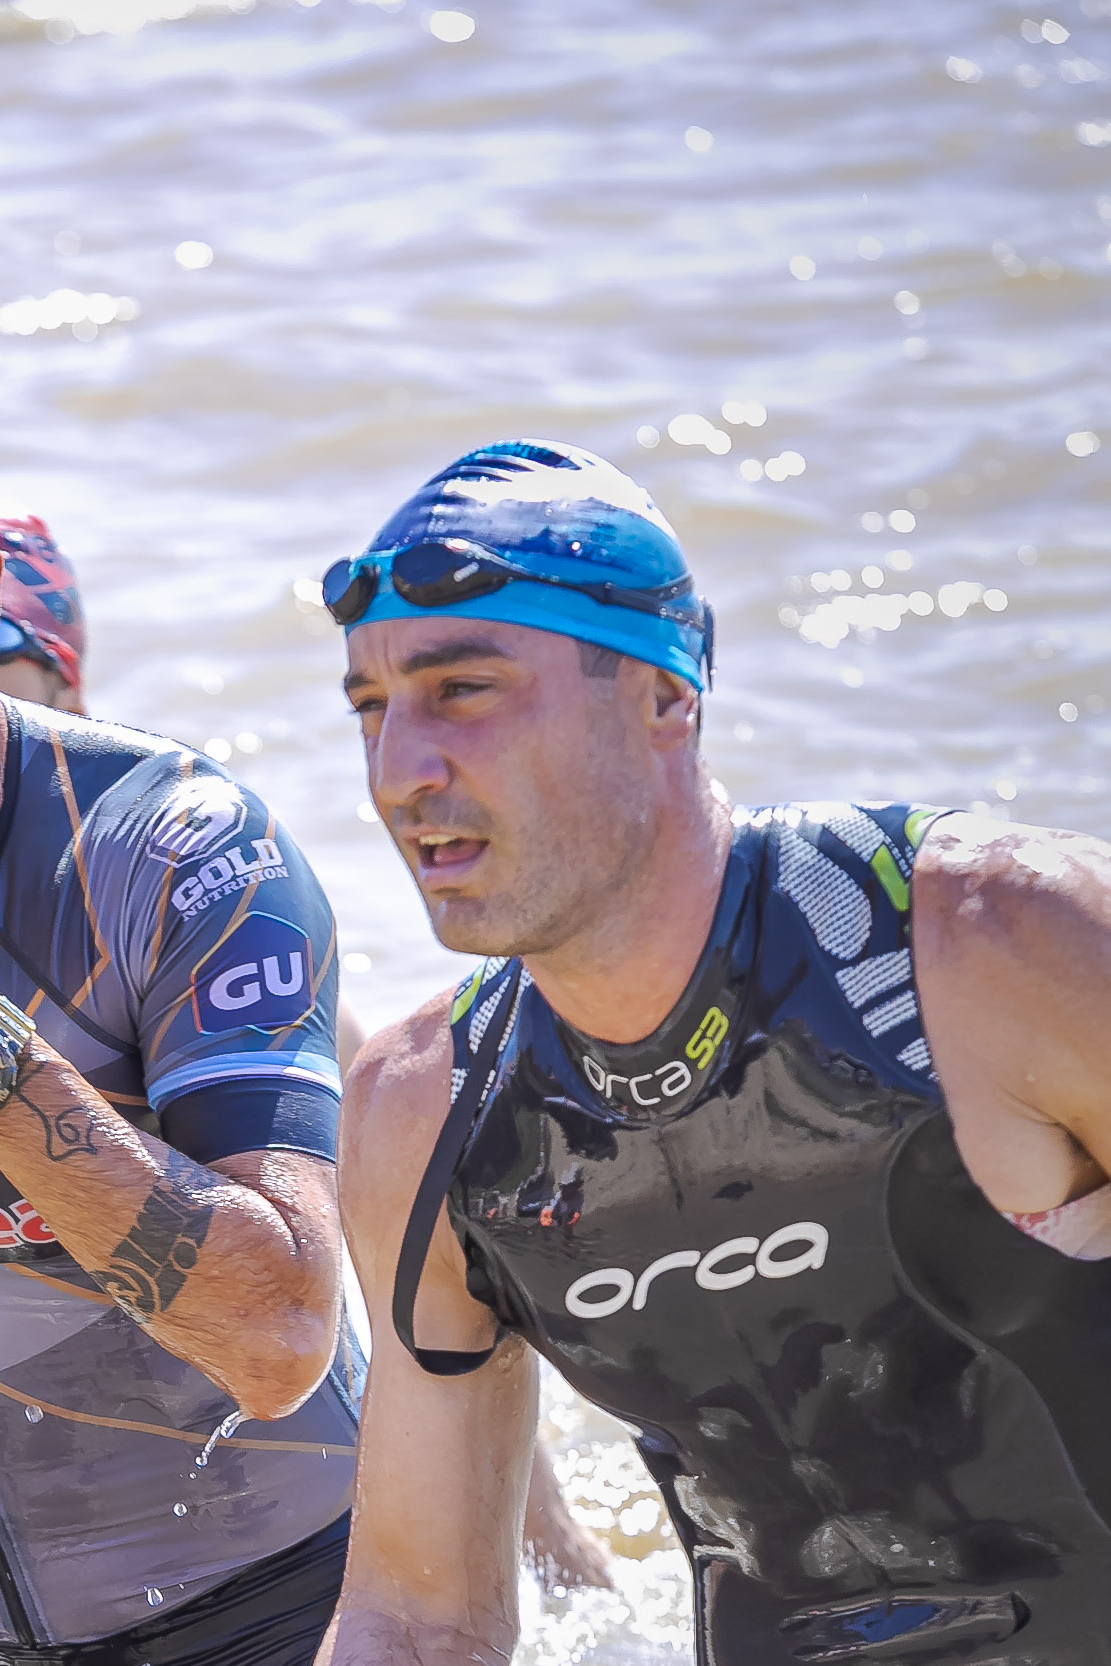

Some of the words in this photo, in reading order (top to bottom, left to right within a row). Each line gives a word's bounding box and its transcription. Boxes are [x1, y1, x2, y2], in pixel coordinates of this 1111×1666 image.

[171, 838, 284, 911] GOLD
[182, 866, 289, 922] NUTRITION
[209, 952, 304, 1010] GU
[582, 1055, 691, 1106] orca
[685, 1006, 729, 1070] S3
[565, 1221, 829, 1319] orca
